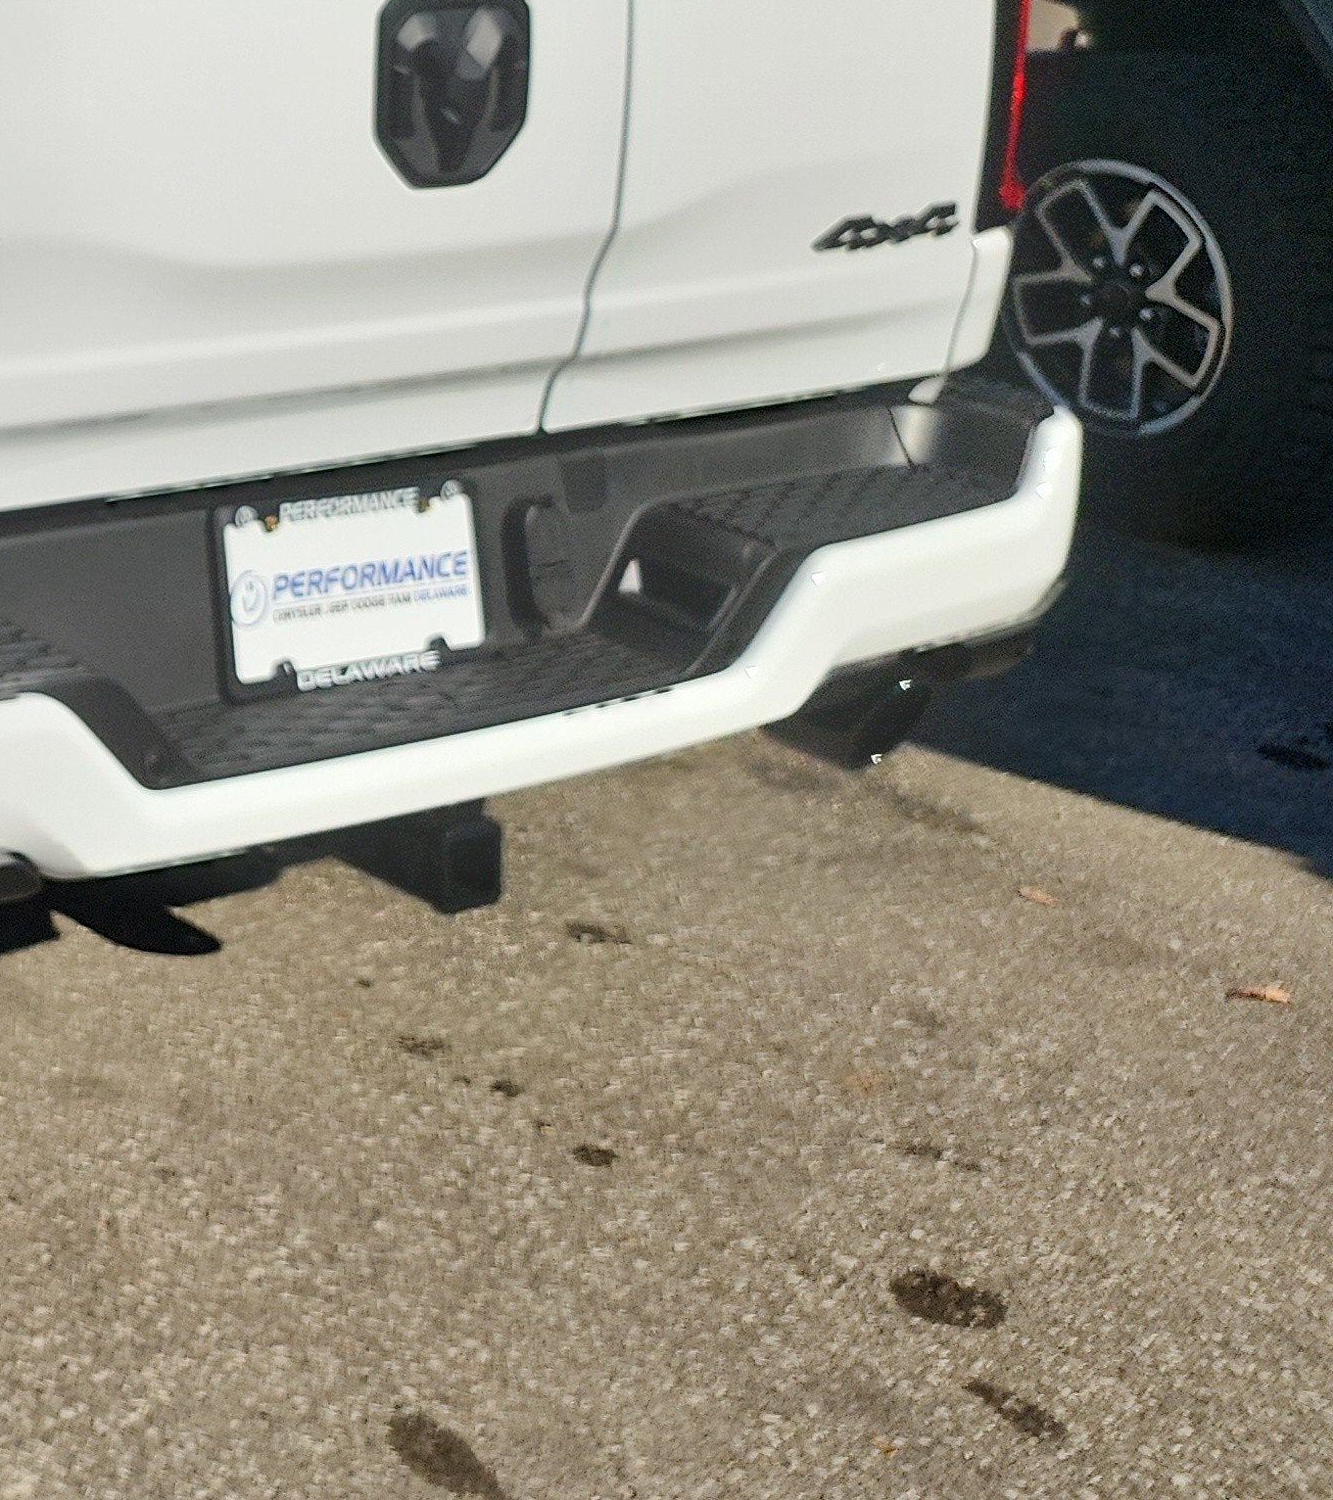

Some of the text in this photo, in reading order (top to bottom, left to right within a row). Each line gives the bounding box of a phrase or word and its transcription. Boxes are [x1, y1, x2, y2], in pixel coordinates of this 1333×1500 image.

[280, 487, 420, 520] PERFORMANCE
[273, 551, 468, 598] PERFORMANCE
[296, 650, 441, 691] DELAWARE
